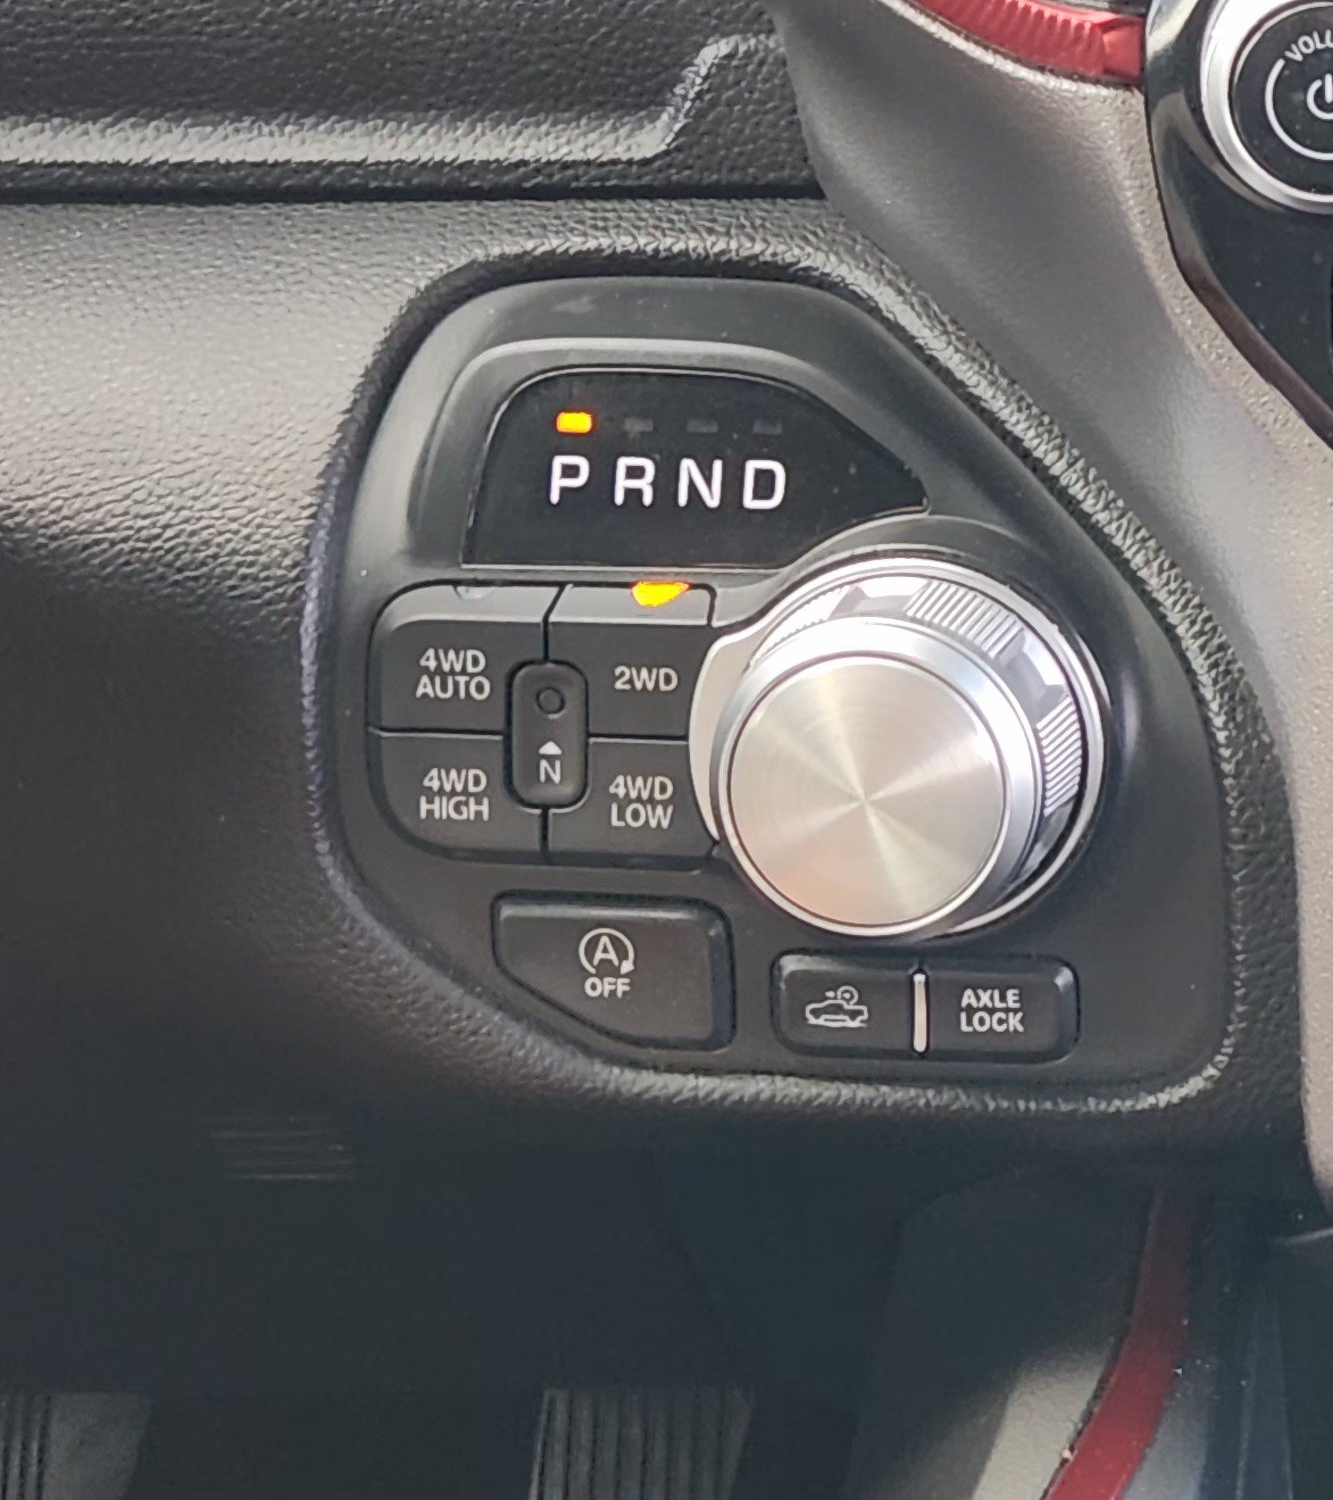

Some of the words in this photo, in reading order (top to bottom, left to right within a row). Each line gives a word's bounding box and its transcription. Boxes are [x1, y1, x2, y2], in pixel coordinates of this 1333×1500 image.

[419, 648, 486, 673] 4WD
[416, 676, 490, 700] AUTO
[614, 666, 678, 691] 2WD
[423, 768, 486, 792] 4WD
[539, 760, 561, 784] N
[609, 774, 673, 800] 4WD
[419, 796, 489, 821] HIGH
[611, 803, 673, 829] LOW
[584, 976, 631, 999] OFF
[960, 988, 1021, 1009] AXLE
[959, 1011, 1024, 1033] LOCK
